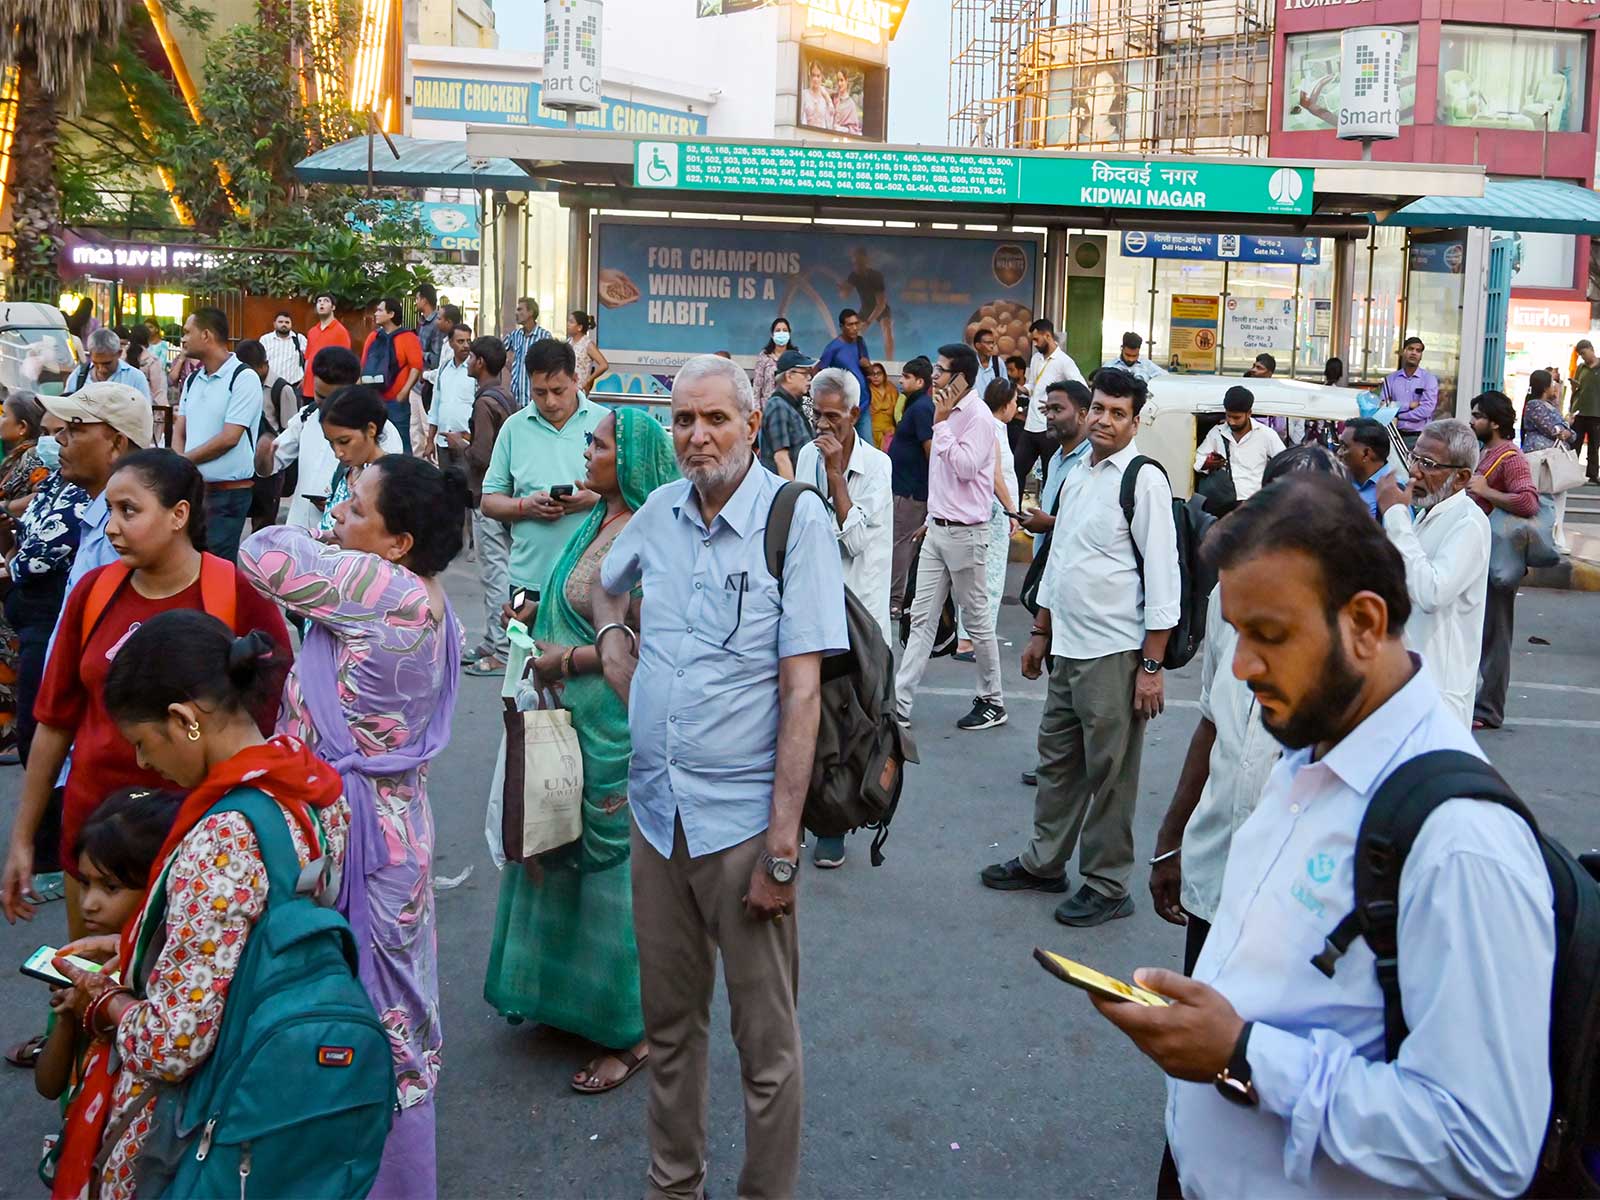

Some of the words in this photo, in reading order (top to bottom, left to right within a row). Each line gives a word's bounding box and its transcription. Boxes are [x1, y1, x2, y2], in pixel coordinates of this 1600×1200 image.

[543, 75, 573, 91] mart
[415, 80, 462, 109] BHARAT
[464, 83, 528, 114] CROCKERY
[507, 114, 528, 124] INA
[1341, 108, 1392, 126] Smart
[1091, 160, 1152, 187] किदवई
[1159, 169, 1199, 186] नगर
[1080, 187, 1142, 206] KIDWAI
[1146, 190, 1207, 208] NAGAR
[649, 248, 682, 269] FOR
[690, 249, 800, 273] CHAMPIONS
[1253, 248, 1269, 256] Gate
[1269, 248, 1279, 256] No.
[1280, 248, 1285, 256] 2
[649, 274, 731, 298] WINNING
[738, 277, 756, 300] IS
[763, 279, 775, 300] A
[648, 301, 715, 326] HABIT.
[638, 355, 690, 366] #YourGold
